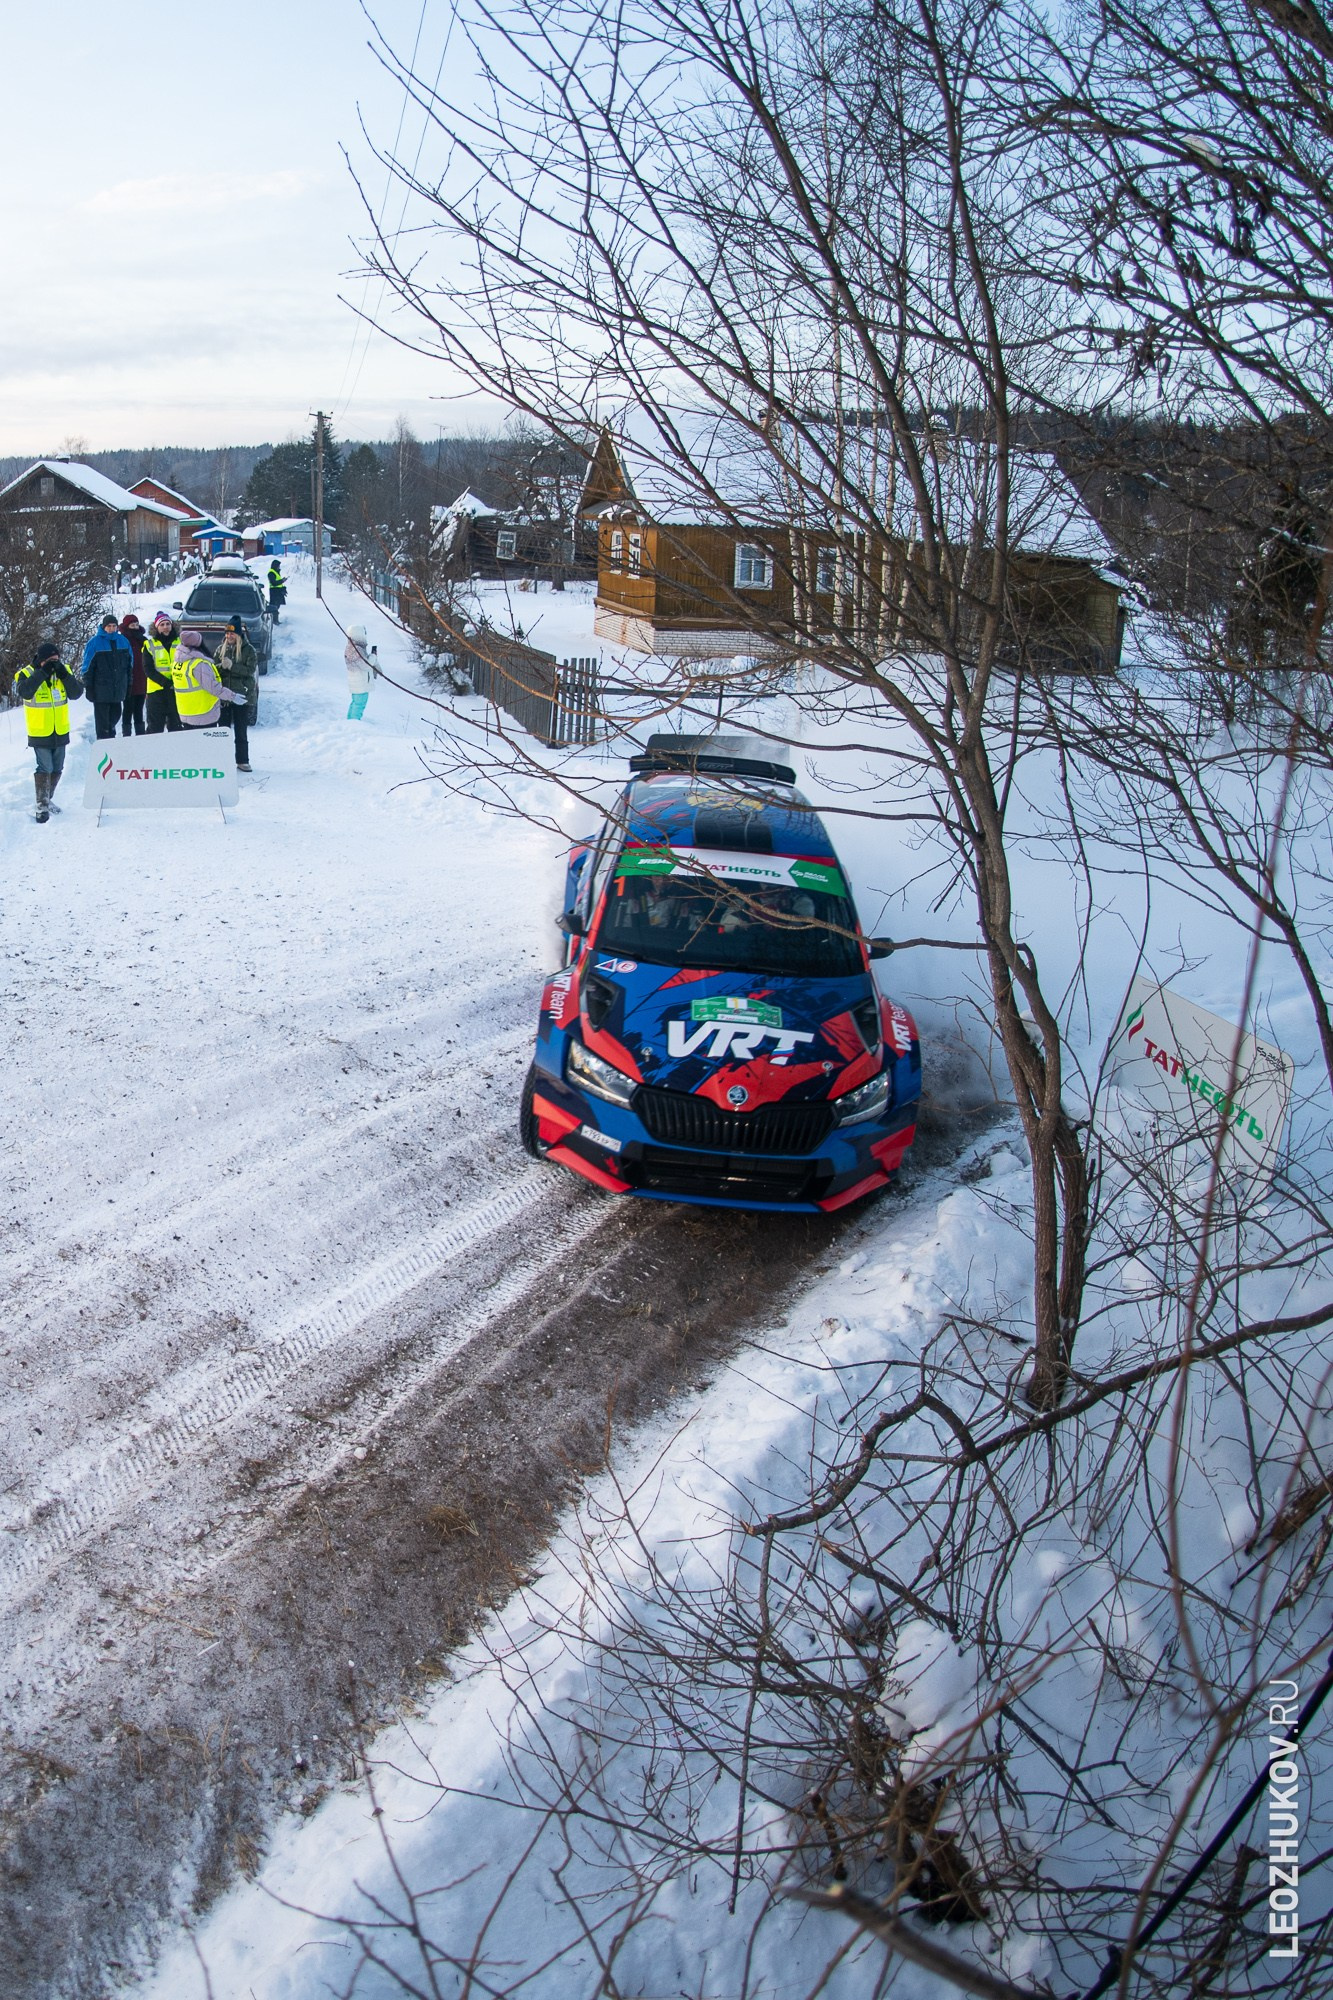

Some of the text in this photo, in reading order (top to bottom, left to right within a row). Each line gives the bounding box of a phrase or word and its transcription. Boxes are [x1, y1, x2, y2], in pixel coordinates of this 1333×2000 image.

[116, 768, 225, 780] ТАТНЕФТЬ
[613, 876, 626, 897] 1
[548, 991, 569, 1020] team
[732, 997, 739, 1009] 1
[667, 1020, 815, 1066] VRT
[891, 1020, 912, 1051] VRT
[1143, 1038, 1264, 1141] ТАТНЕФТЬ
